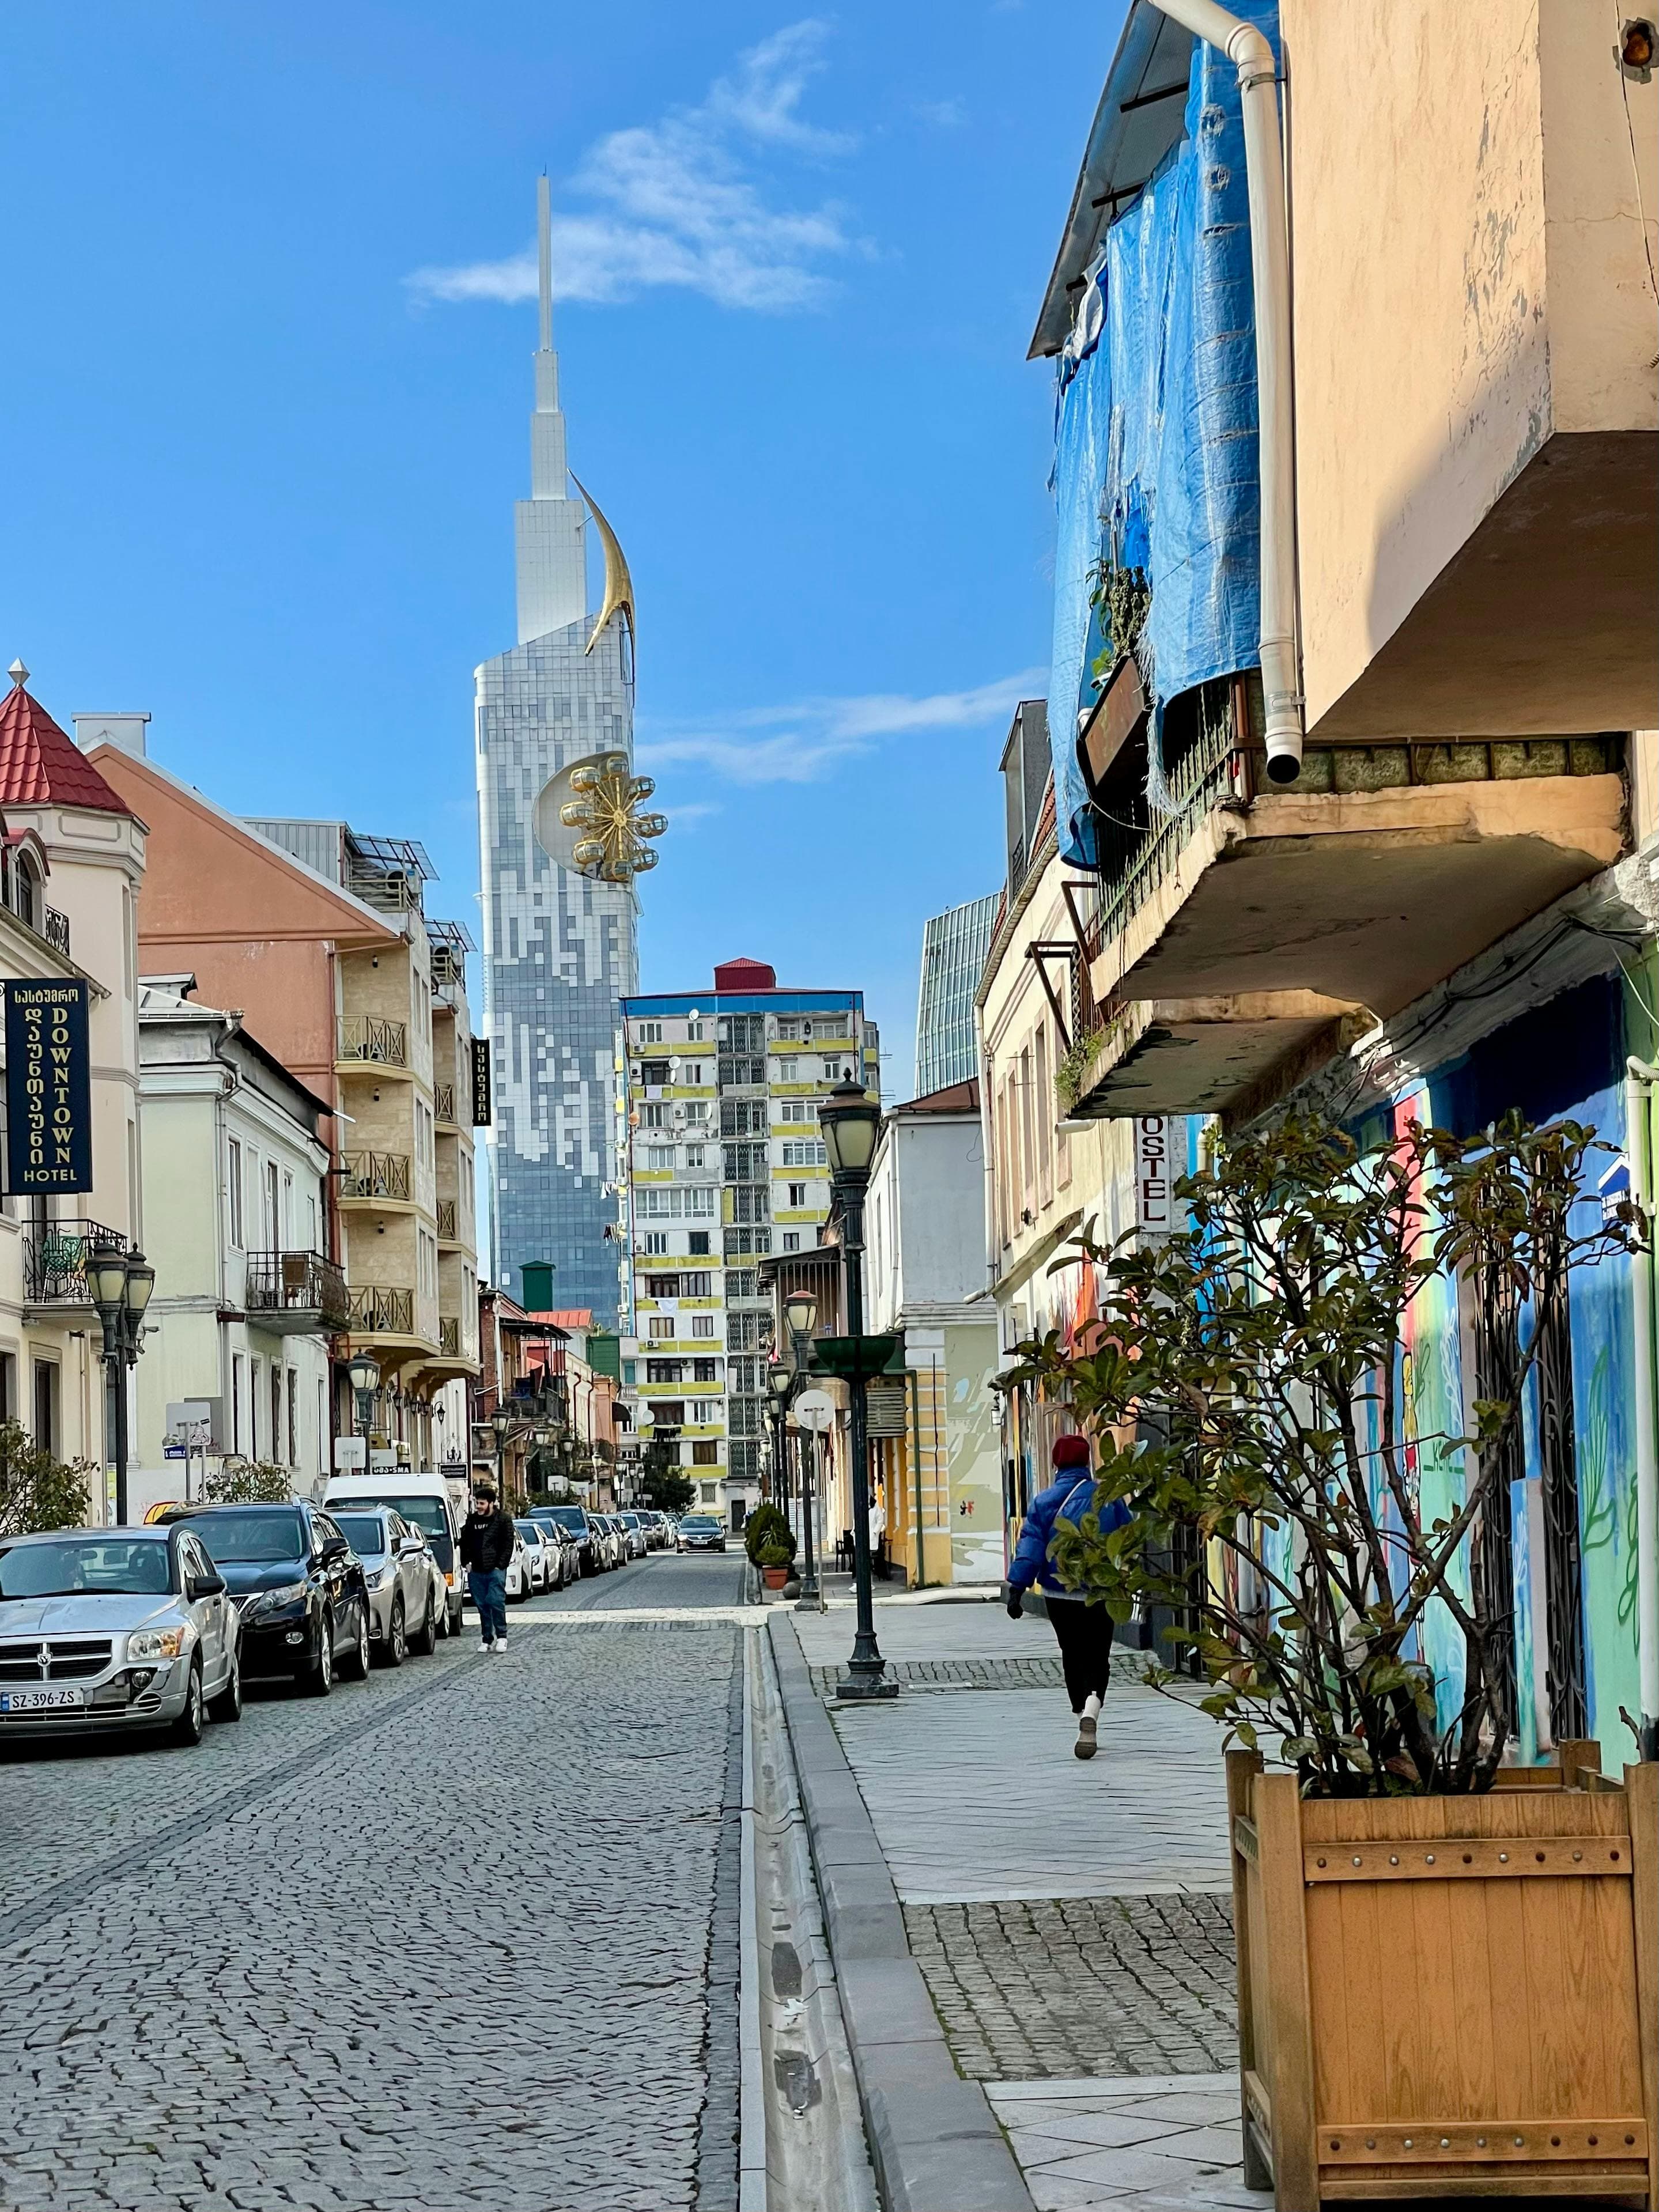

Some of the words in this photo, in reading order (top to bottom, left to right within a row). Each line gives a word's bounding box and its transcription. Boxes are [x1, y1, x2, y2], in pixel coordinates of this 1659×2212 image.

[14, 989, 78, 1003] სასტუმრო
[25, 1008, 44, 1164] დაუნთაუნი
[50, 1008, 74, 1163] DOWNTOWN
[24, 1169, 77, 1182] HOTEL
[13, 1691, 74, 1708] SZ-396-ZS
